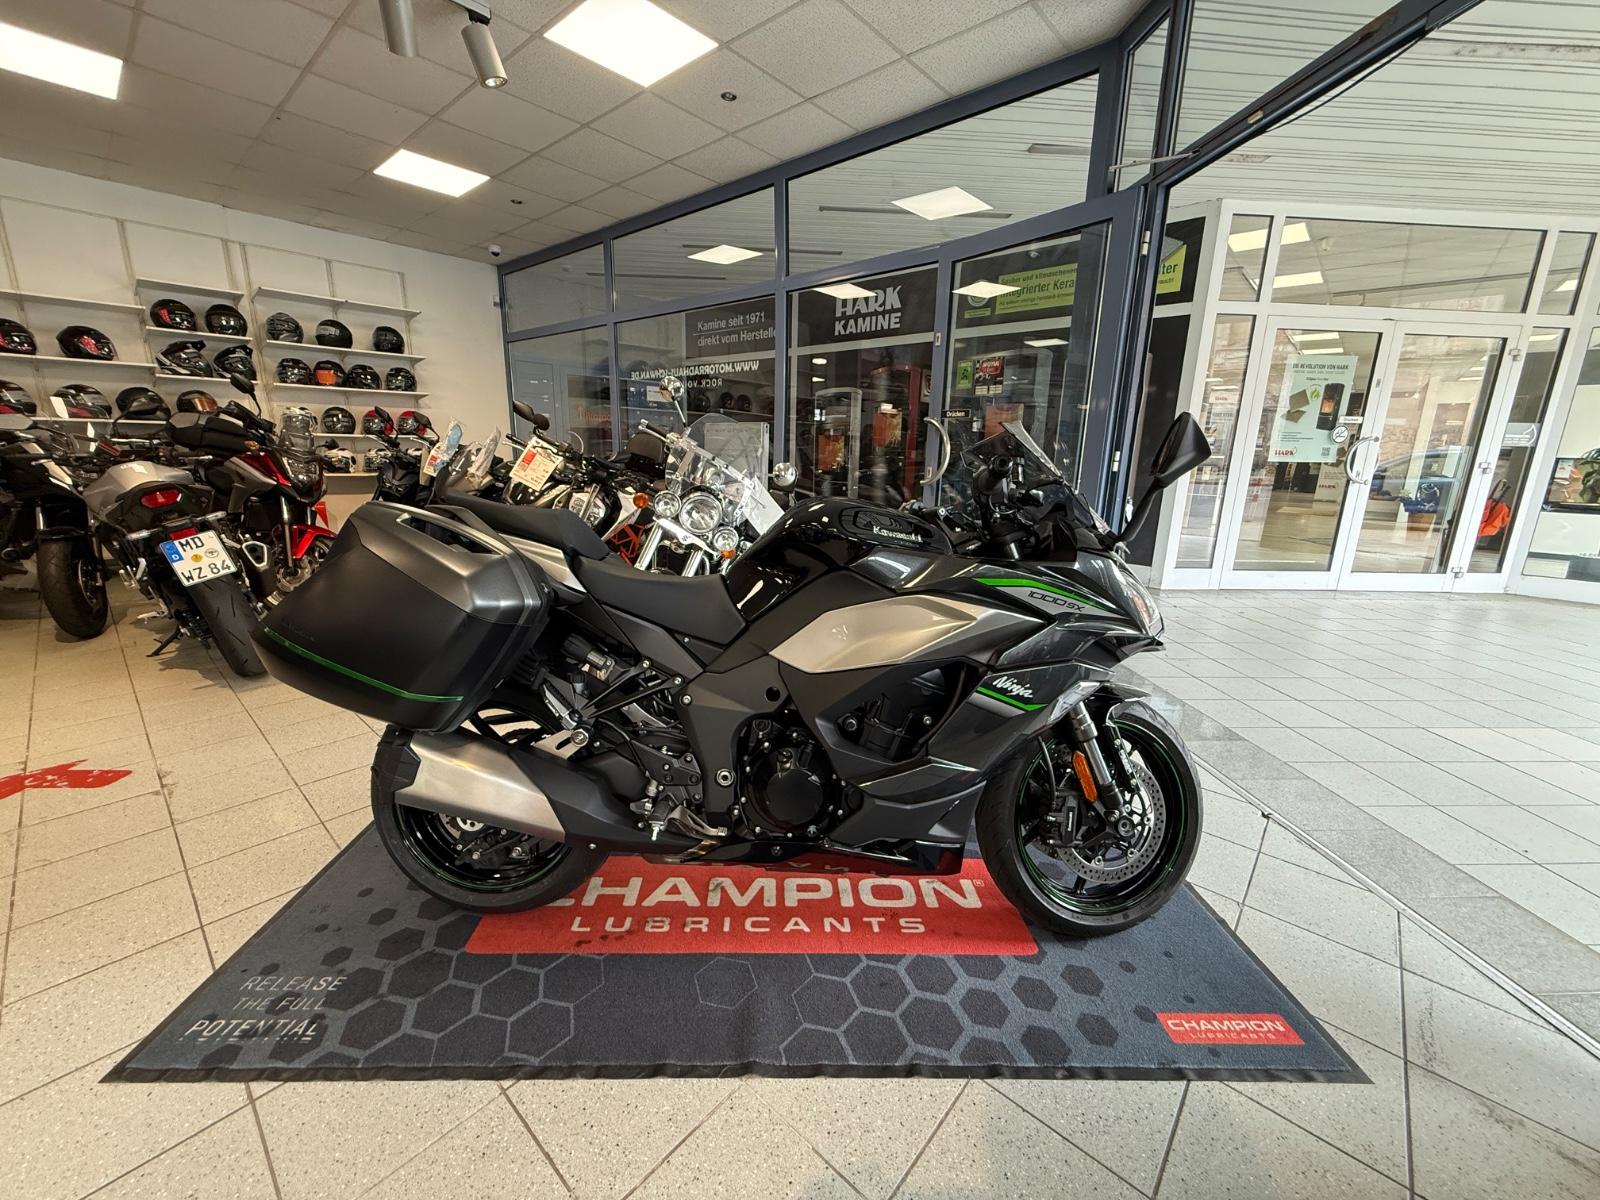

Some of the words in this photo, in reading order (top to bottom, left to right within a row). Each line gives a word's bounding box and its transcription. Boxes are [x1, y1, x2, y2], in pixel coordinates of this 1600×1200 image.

[1053, 279, 1075, 290] Kera
[835, 285, 902, 318] HARK
[697, 317, 727, 331] Kamine
[728, 314, 743, 327] seit
[745, 311, 765, 324] 1971
[834, 312, 902, 336] KAMINE
[697, 335, 720, 347] direkt
[721, 334, 739, 344] vom
[873, 525, 923, 543] Kawasaki
[178, 536, 205, 552] MD
[181, 566, 208, 583] WZ
[208, 560, 231, 575] 84
[992, 676, 1033, 698] Ninja
[547, 876, 983, 909] HAMPION
[570, 916, 926, 933] LUBRICANTS
[240, 976, 347, 991] RELEASE
[232, 997, 274, 1011] THE
[275, 997, 327, 1011] FULL
[184, 1019, 319, 1038] POTENTIAL
[1167, 1019, 1286, 1032] CHAMPION
[1190, 1032, 1277, 1040] LUBRICANTS
